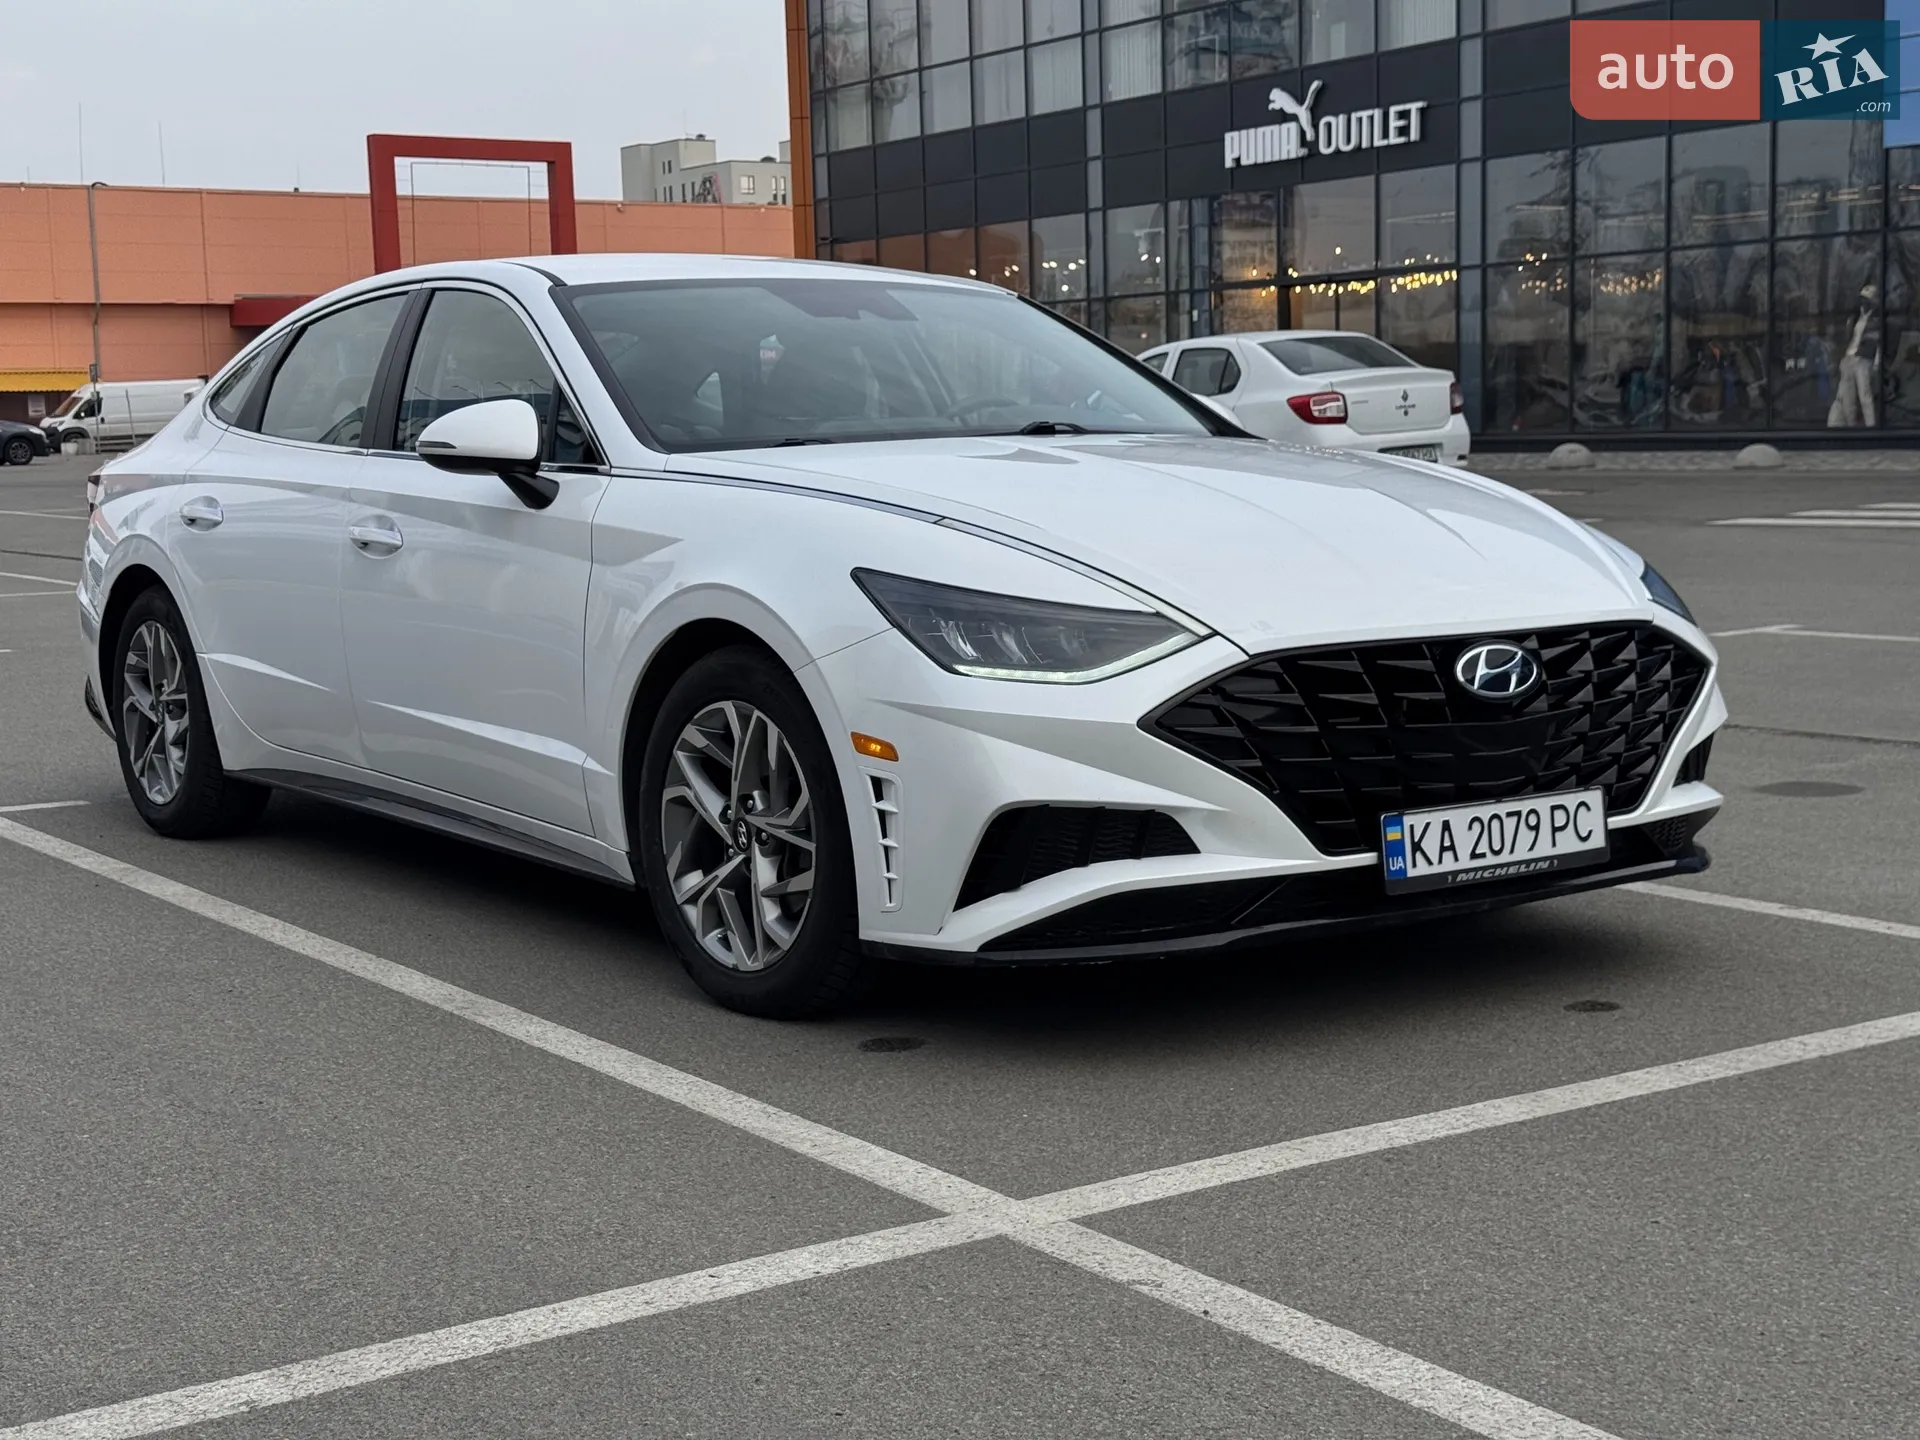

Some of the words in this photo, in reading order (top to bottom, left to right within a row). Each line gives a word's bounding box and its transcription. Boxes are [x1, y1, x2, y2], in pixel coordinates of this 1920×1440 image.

[1224, 121, 1300, 169] PUMA
[1318, 100, 1428, 155] OUTLET
[1409, 819, 1459, 869] KA
[1467, 807, 1541, 861] 2079
[1550, 800, 1594, 849] PC
[1389, 855, 1405, 871] UA
[1456, 860, 1550, 882] MICHELIN
